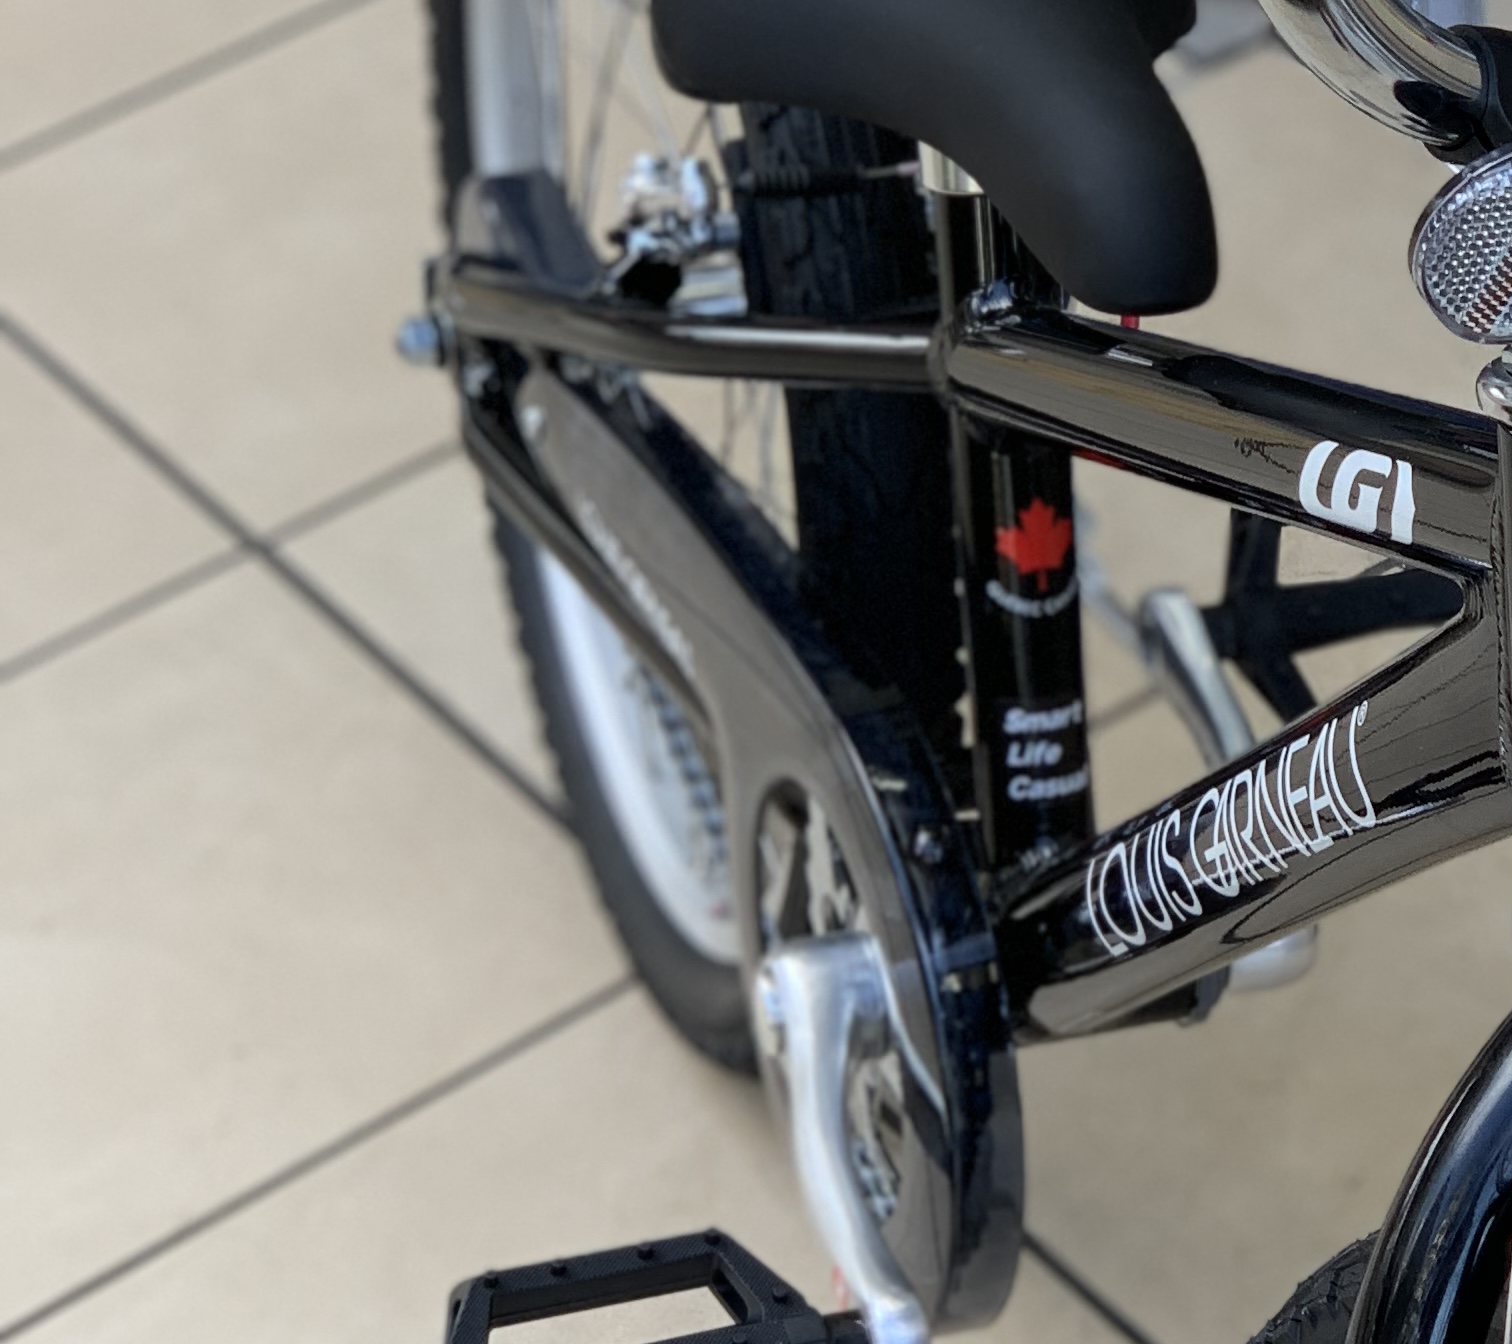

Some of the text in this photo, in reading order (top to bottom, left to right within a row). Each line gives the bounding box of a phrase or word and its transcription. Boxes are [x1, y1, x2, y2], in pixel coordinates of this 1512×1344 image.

[1002, 699, 1082, 734] Smart
[1006, 739, 1063, 768] Life
[1086, 809, 1203, 956] LOUIS
